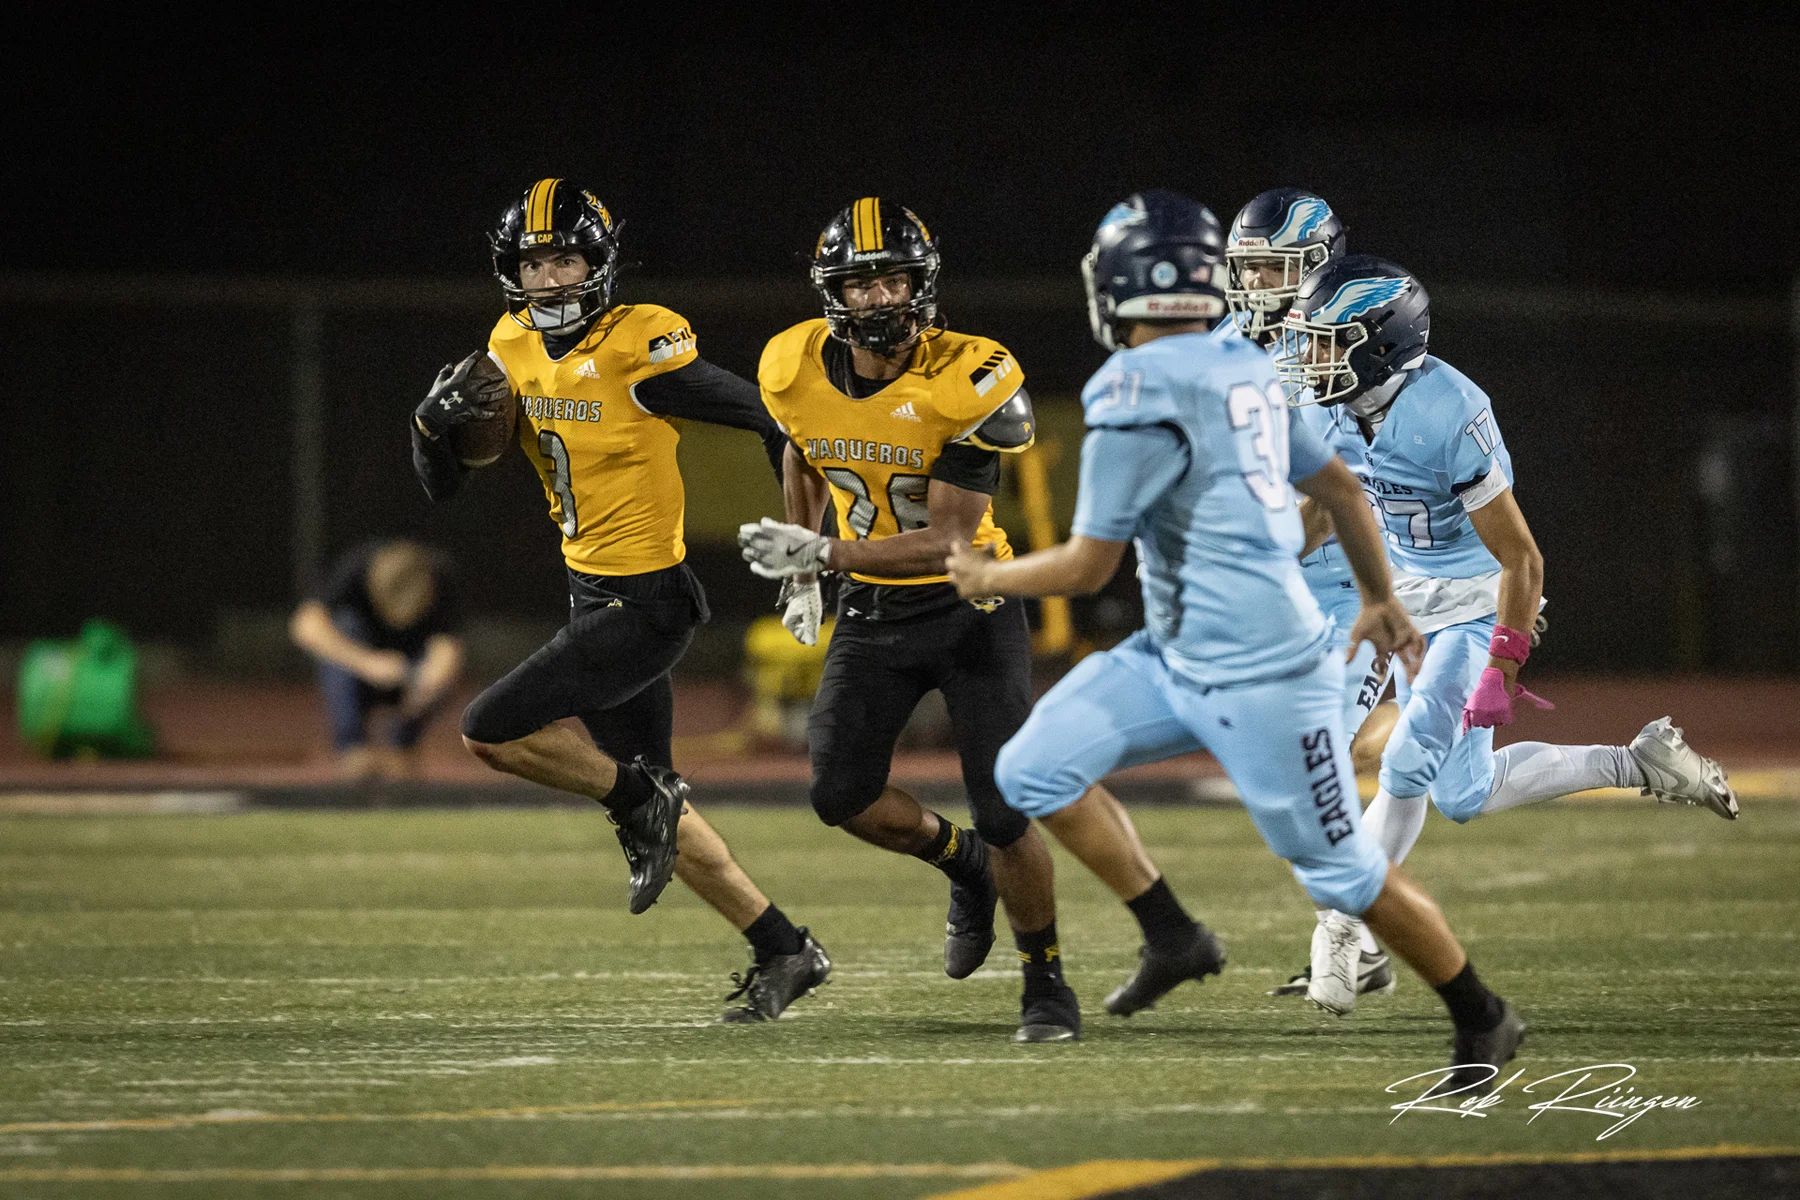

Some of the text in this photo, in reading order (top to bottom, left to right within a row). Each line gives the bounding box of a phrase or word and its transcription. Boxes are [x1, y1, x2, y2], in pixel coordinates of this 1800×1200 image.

[537, 233, 553, 243] CAP
[1238, 239, 1265, 247] Riddell
[574, 369, 601, 379] adidas
[1464, 407, 1498, 457] 17
[806, 438, 924, 469] VAQUEROS
[538, 429, 578, 538] 3
[1302, 726, 1354, 847] EAGLES
